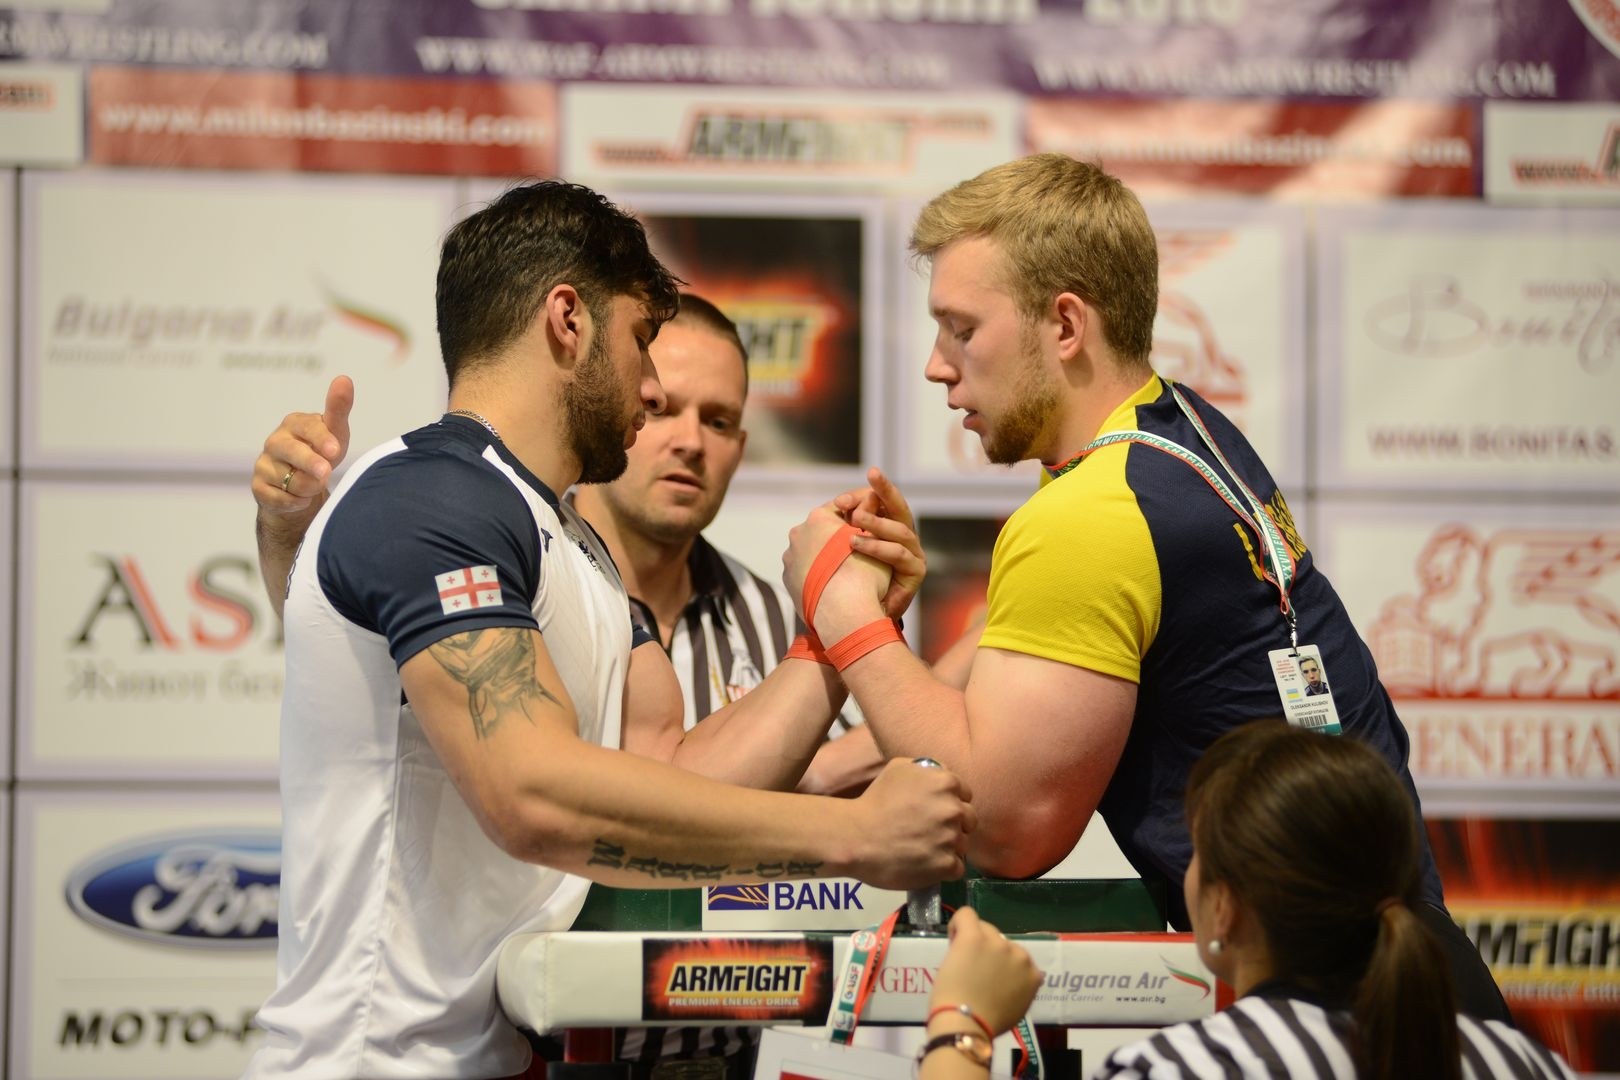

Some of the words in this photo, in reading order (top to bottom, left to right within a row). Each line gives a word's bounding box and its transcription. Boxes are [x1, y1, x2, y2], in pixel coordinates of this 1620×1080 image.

[774, 882, 864, 911] BANK
[669, 965, 807, 992] ARMFIGHT
[1135, 973, 1169, 989] Air
[669, 997, 720, 1007] PREMIUM
[722, 997, 763, 1007] ENERGY
[766, 997, 799, 1007] DRINK
